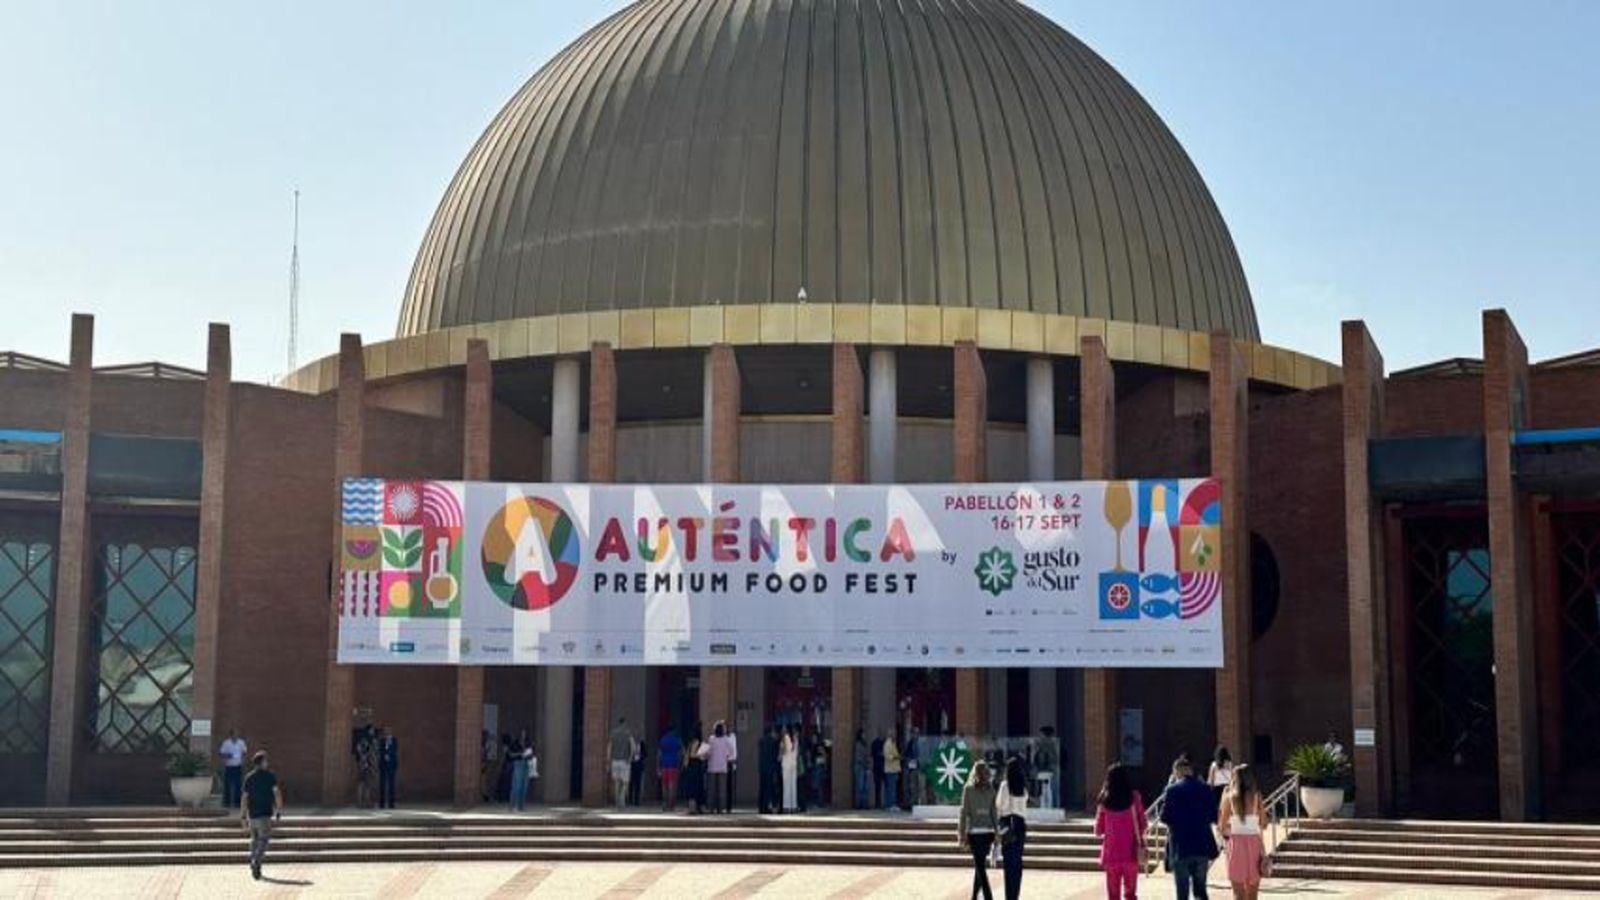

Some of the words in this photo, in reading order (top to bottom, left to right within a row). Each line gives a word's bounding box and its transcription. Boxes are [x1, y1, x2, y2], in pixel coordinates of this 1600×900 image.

[945, 491, 1032, 510] PABELLÓN
[1038, 494, 1047, 508] 1
[1053, 493, 1065, 508] &
[1071, 493, 1081, 508] 2
[594, 501, 916, 563] AUTÉNTICA
[1041, 514, 1081, 530] SEPT
[941, 551, 957, 566] by
[1023, 547, 1081, 577] gusto
[594, 573, 728, 594] PREMIUM
[746, 573, 828, 594] FOOD
[845, 573, 917, 594] FEST
[1042, 568, 1081, 591] Sur
